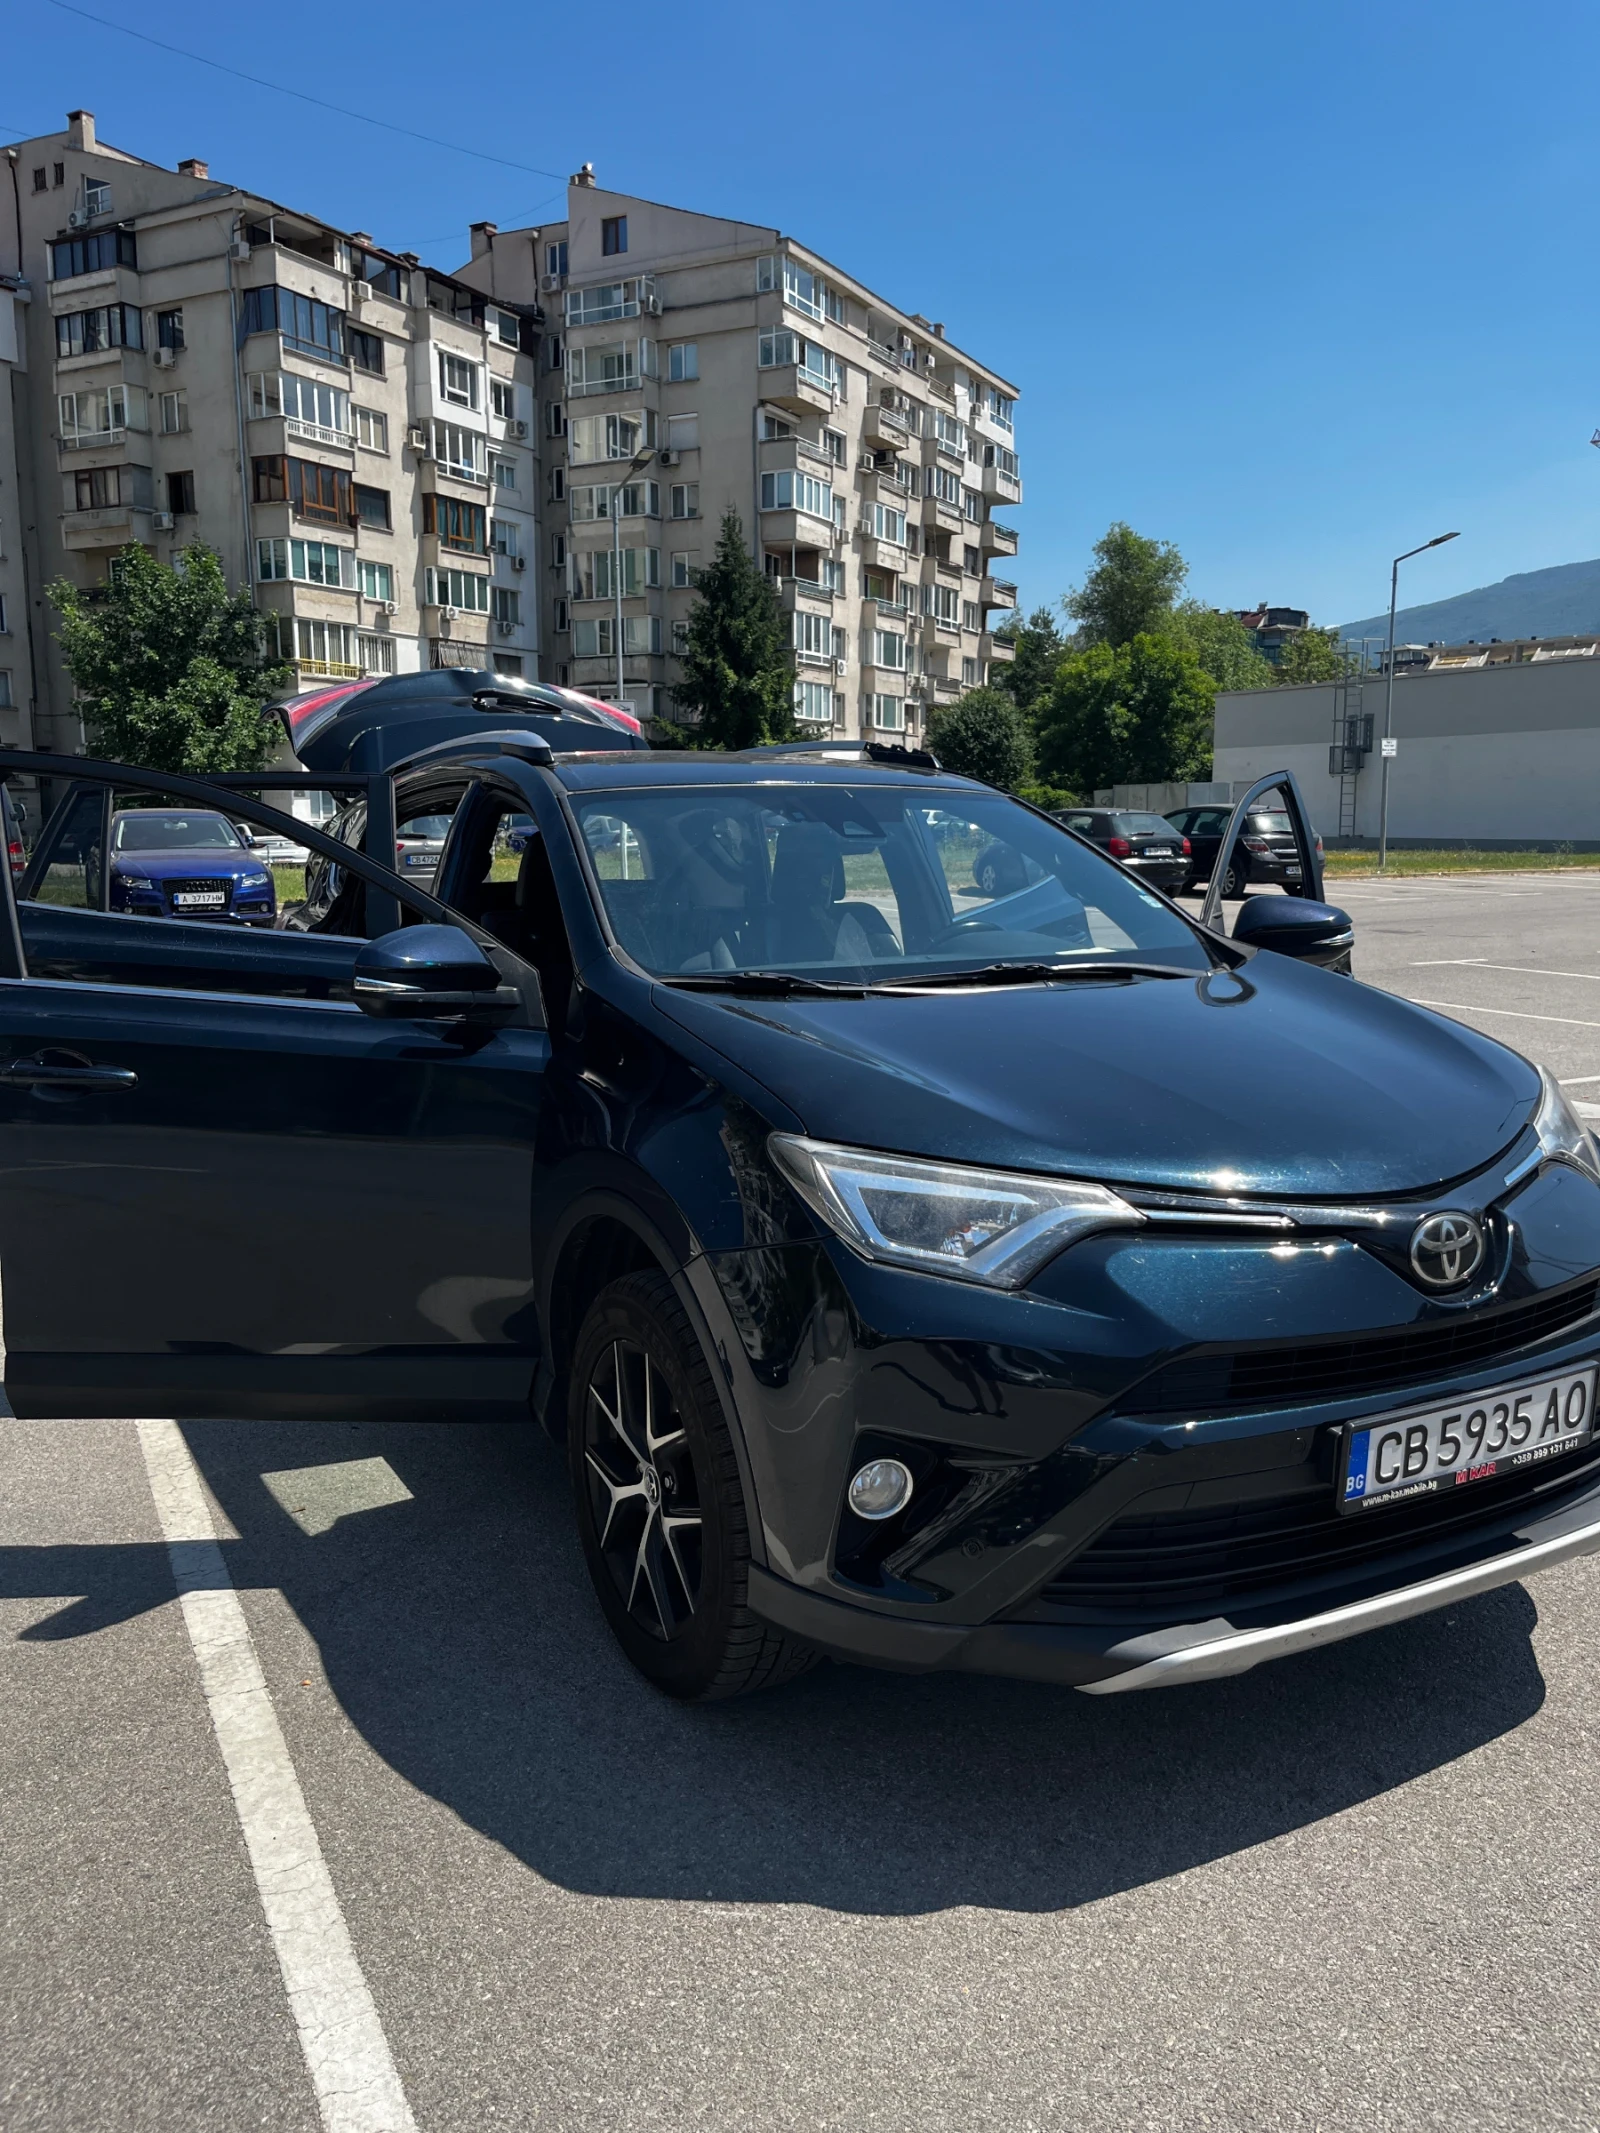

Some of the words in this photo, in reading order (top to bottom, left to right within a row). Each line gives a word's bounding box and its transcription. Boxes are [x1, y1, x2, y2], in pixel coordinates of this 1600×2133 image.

[183, 895, 188, 903] A
[192, 894, 211, 903] 3717
[1374, 1424, 1429, 1485] CB
[1437, 1394, 1533, 1467] 5935
[1540, 1380, 1587, 1439] AO
[1512, 1452, 1532, 1465] +359
[1533, 1447, 1548, 1460] 899
[1549, 1442, 1563, 1455] 131
[1346, 1473, 1365, 1493] BG
[1455, 1468, 1468, 1485] M
[1469, 1461, 1497, 1480] KAR
